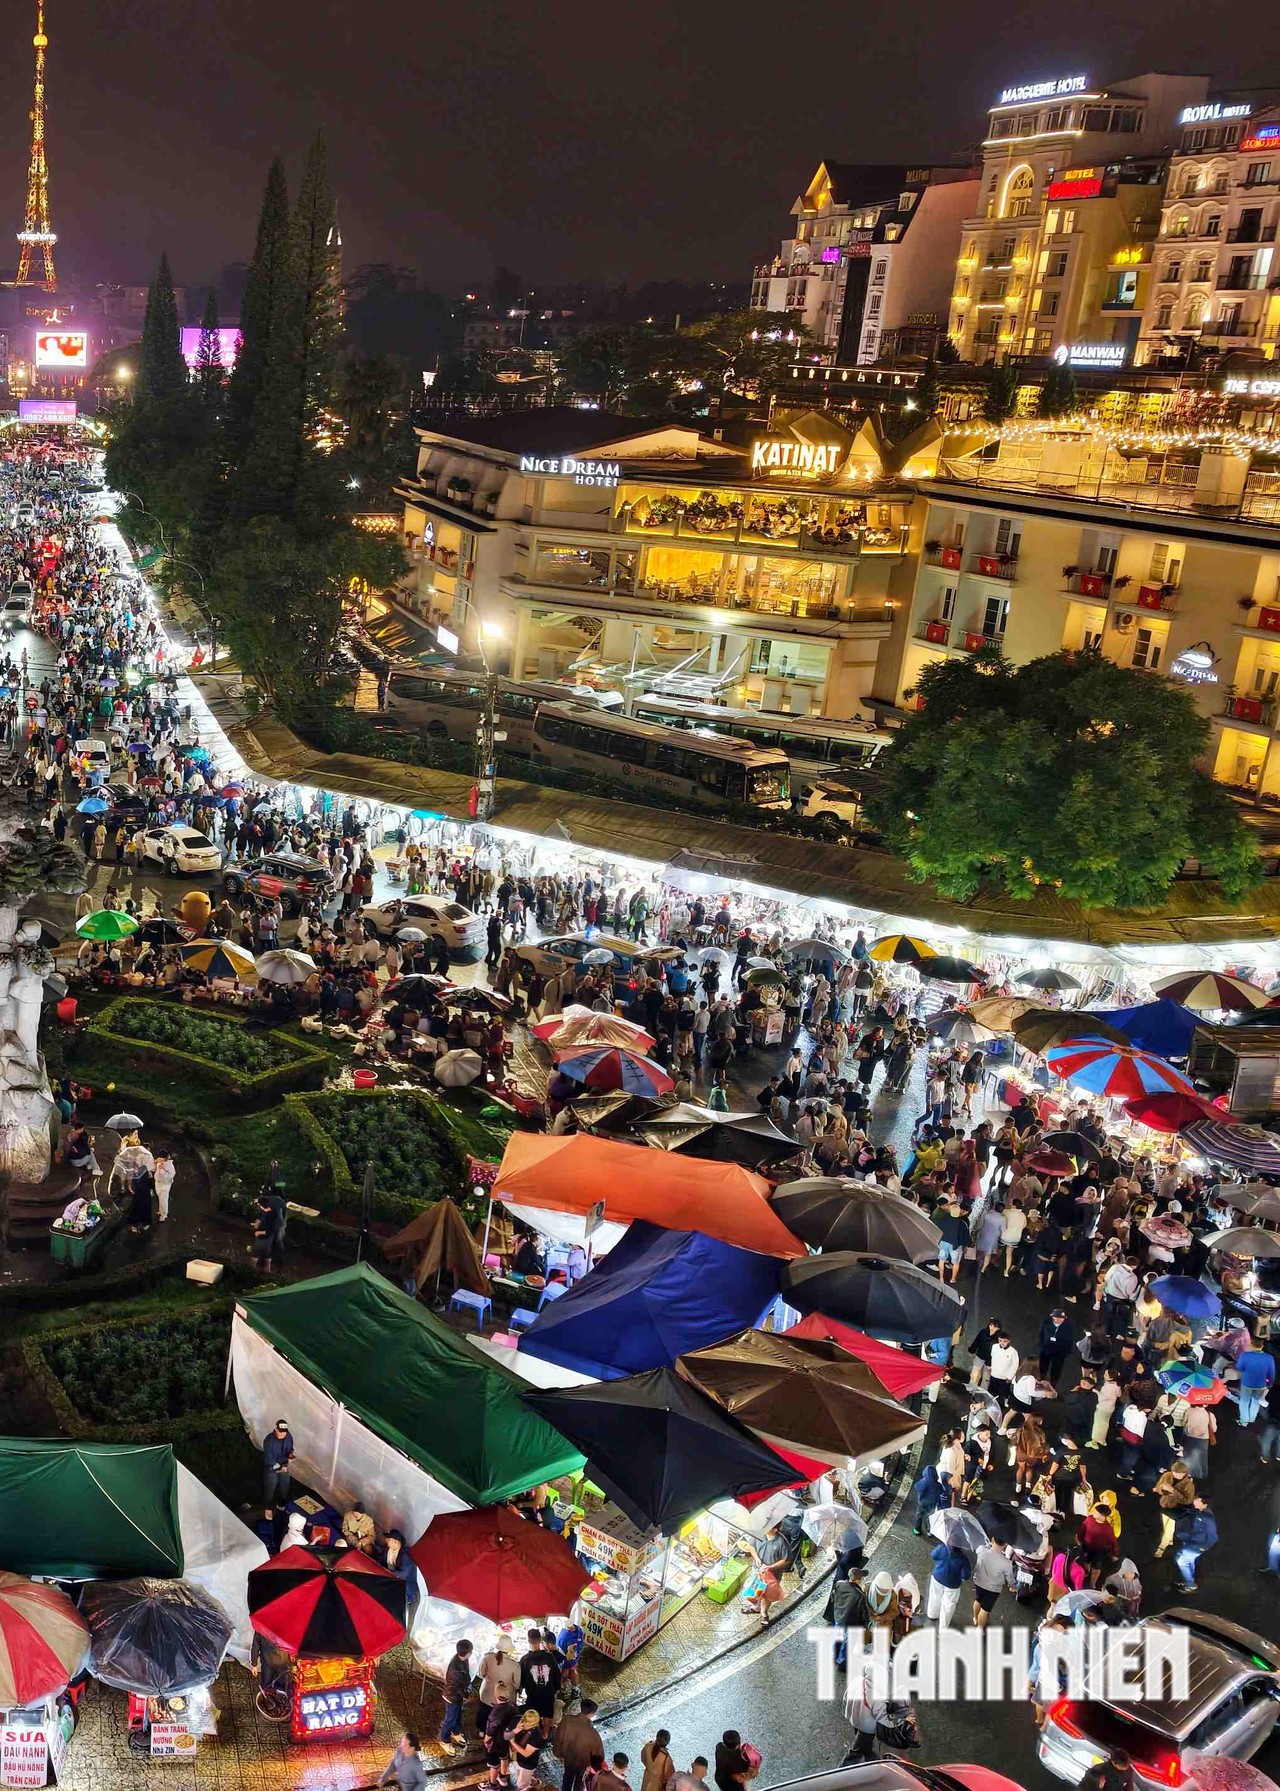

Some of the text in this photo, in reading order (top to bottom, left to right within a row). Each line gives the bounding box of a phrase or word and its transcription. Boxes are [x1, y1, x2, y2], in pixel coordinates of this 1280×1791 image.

[1001, 76, 1087, 103] MARGUERITE HOTEL
[1180, 104, 1252, 123] ROYAL HOTEL
[16, 231, 58, 243] vinaphone
[1070, 345, 1125, 359] MANWAH
[1225, 380, 1249, 393] THE
[752, 441, 841, 473] KATINAT
[520, 456, 620, 476] NICE DREAM
[576, 475, 618, 487] HOTEL
[598, 1543, 614, 1557] 49K
[586, 1620, 603, 1638] 49K
[302, 1698, 340, 1715] HẠT
[308, 1712, 360, 1730] RANG
[165, 1746, 176, 1754] ZIN
